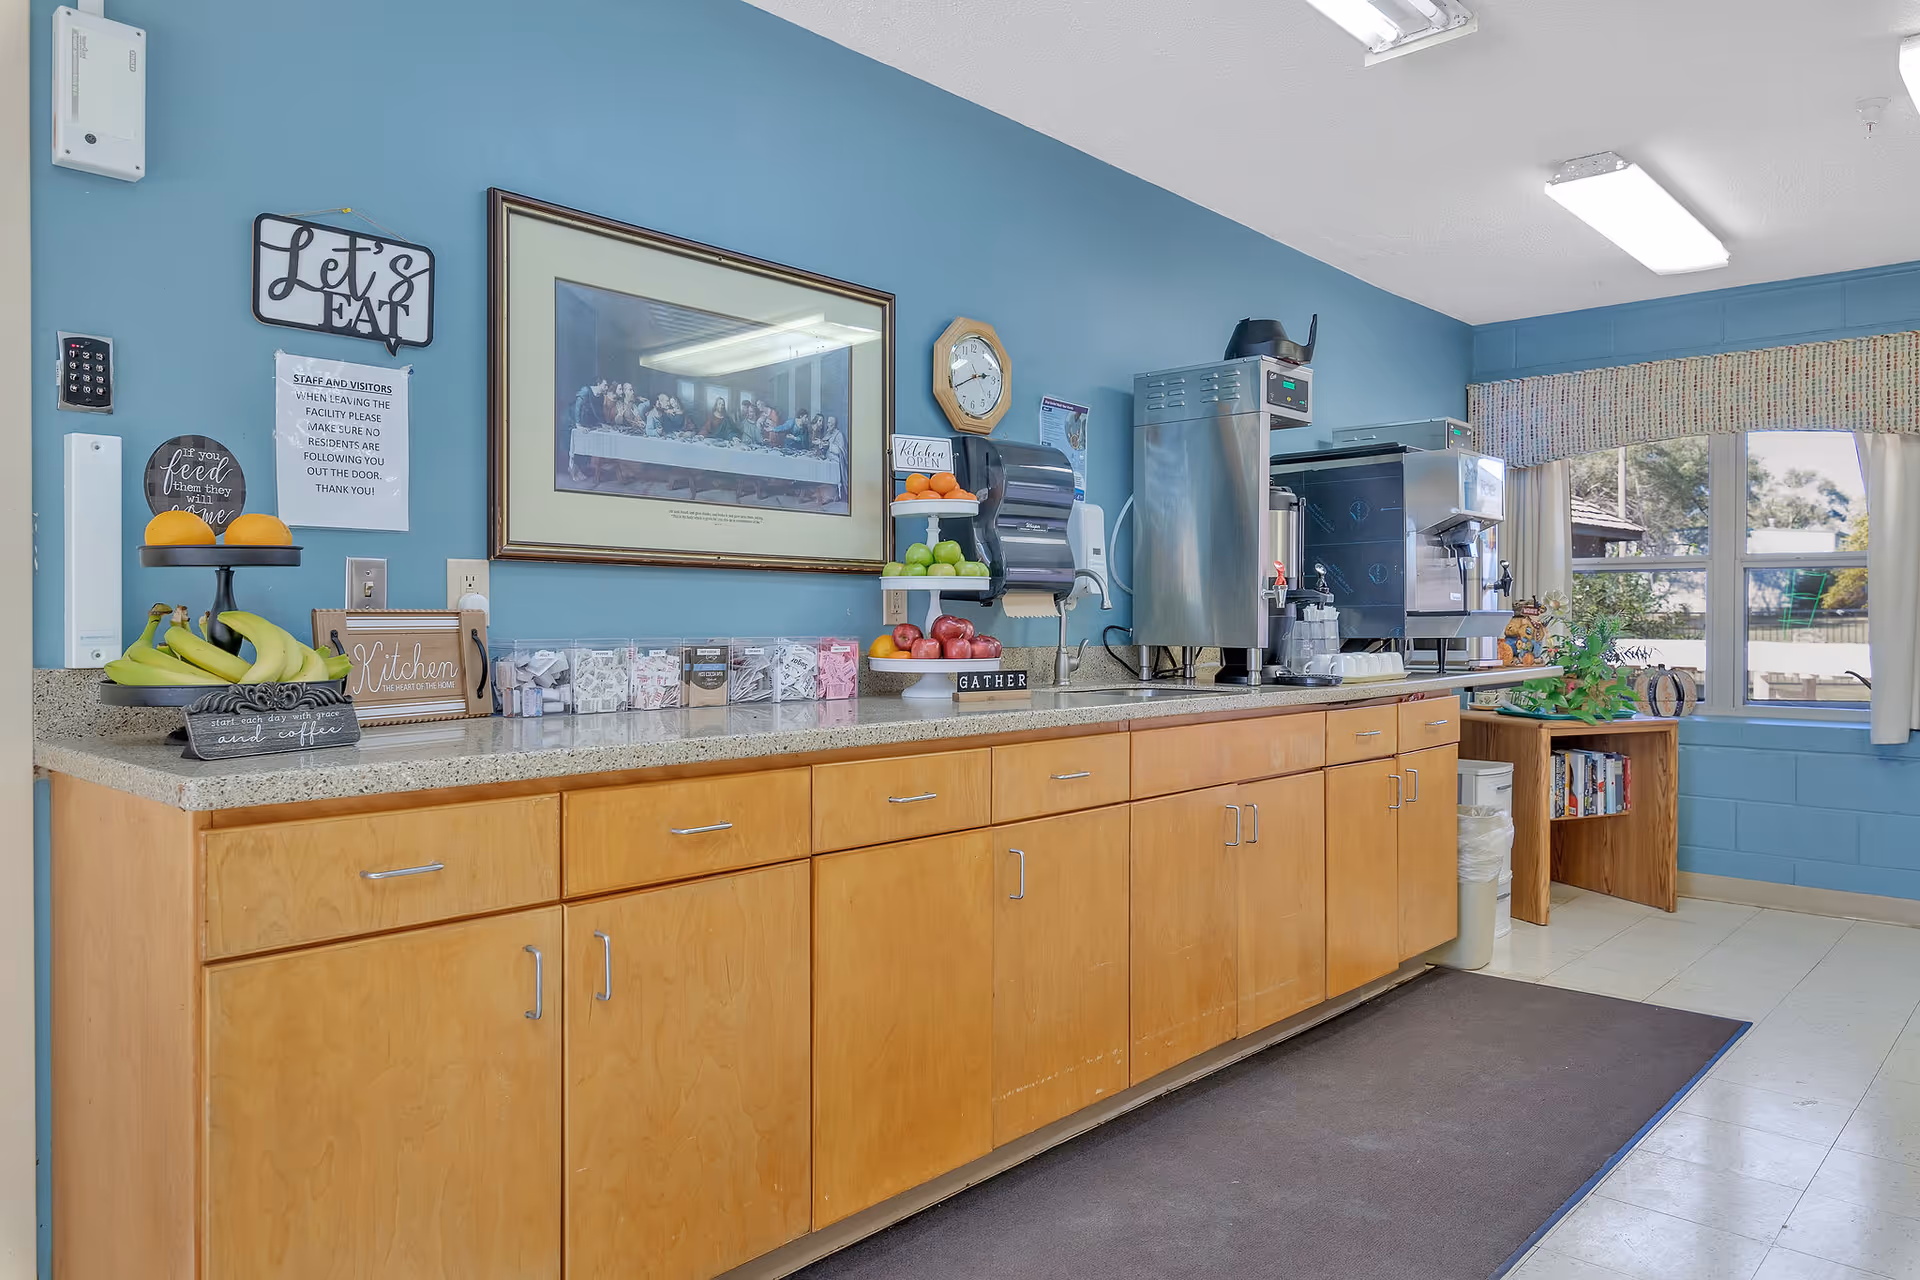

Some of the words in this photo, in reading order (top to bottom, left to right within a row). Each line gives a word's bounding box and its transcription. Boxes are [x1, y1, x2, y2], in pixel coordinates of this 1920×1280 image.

[260, 226, 430, 303] Let's
[318, 290, 410, 339] EAT
[970, 344, 977, 353] 12
[293, 373, 324, 386] STAFF
[325, 378, 348, 388] AND
[350, 380, 393, 394] VISITORS
[990, 376, 996, 385] 3
[296, 390, 327, 403] WHEN
[329, 394, 370, 407] LEAVING
[373, 399, 391, 409] THE
[970, 400, 975, 409] 6
[980, 399, 985, 407] 5
[305, 407, 346, 419] FACILITY
[348, 411, 382, 423] PLEASE
[307, 423, 336, 433] MAKE
[338, 425, 363, 436] SURE
[365, 428, 381, 437] NO
[308, 437, 360, 450] RESIDENTS
[361, 442, 380, 451] ARE
[900, 440, 946, 458] Kitchen
[182, 448, 196, 458] If
[198, 451, 220, 461] you
[303, 451, 362, 465] FOLLOWING
[364, 456, 385, 466] YOU
[906, 455, 940, 468] OPEN
[160, 449, 234, 495] feed
[306, 466, 328, 477] OUT
[330, 468, 349, 478] THE
[351, 470, 383, 480] DOOR.
[172, 481, 202, 493] them
[204, 482, 232, 498] they
[315, 483, 349, 494] THANK
[350, 486, 375, 496] YOU!
[186, 494, 213, 505] will
[352, 641, 459, 695] Kitchen
[791, 658, 808, 670] Sugar
[382, 684, 395, 692] THE
[395, 683, 415, 691] HEART
[415, 682, 425, 690] OF
[425, 681, 437, 690] THE
[437, 680, 455, 689] HOME
[959, 673, 1027, 689] GATHER
[211, 718, 235, 727] start
[241, 715, 263, 724] each
[267, 714, 287, 723] day
[292, 711, 311, 720] with
[315, 711, 340, 720] grace
[218, 724, 266, 744] and
[278, 720, 342, 746] coffee
